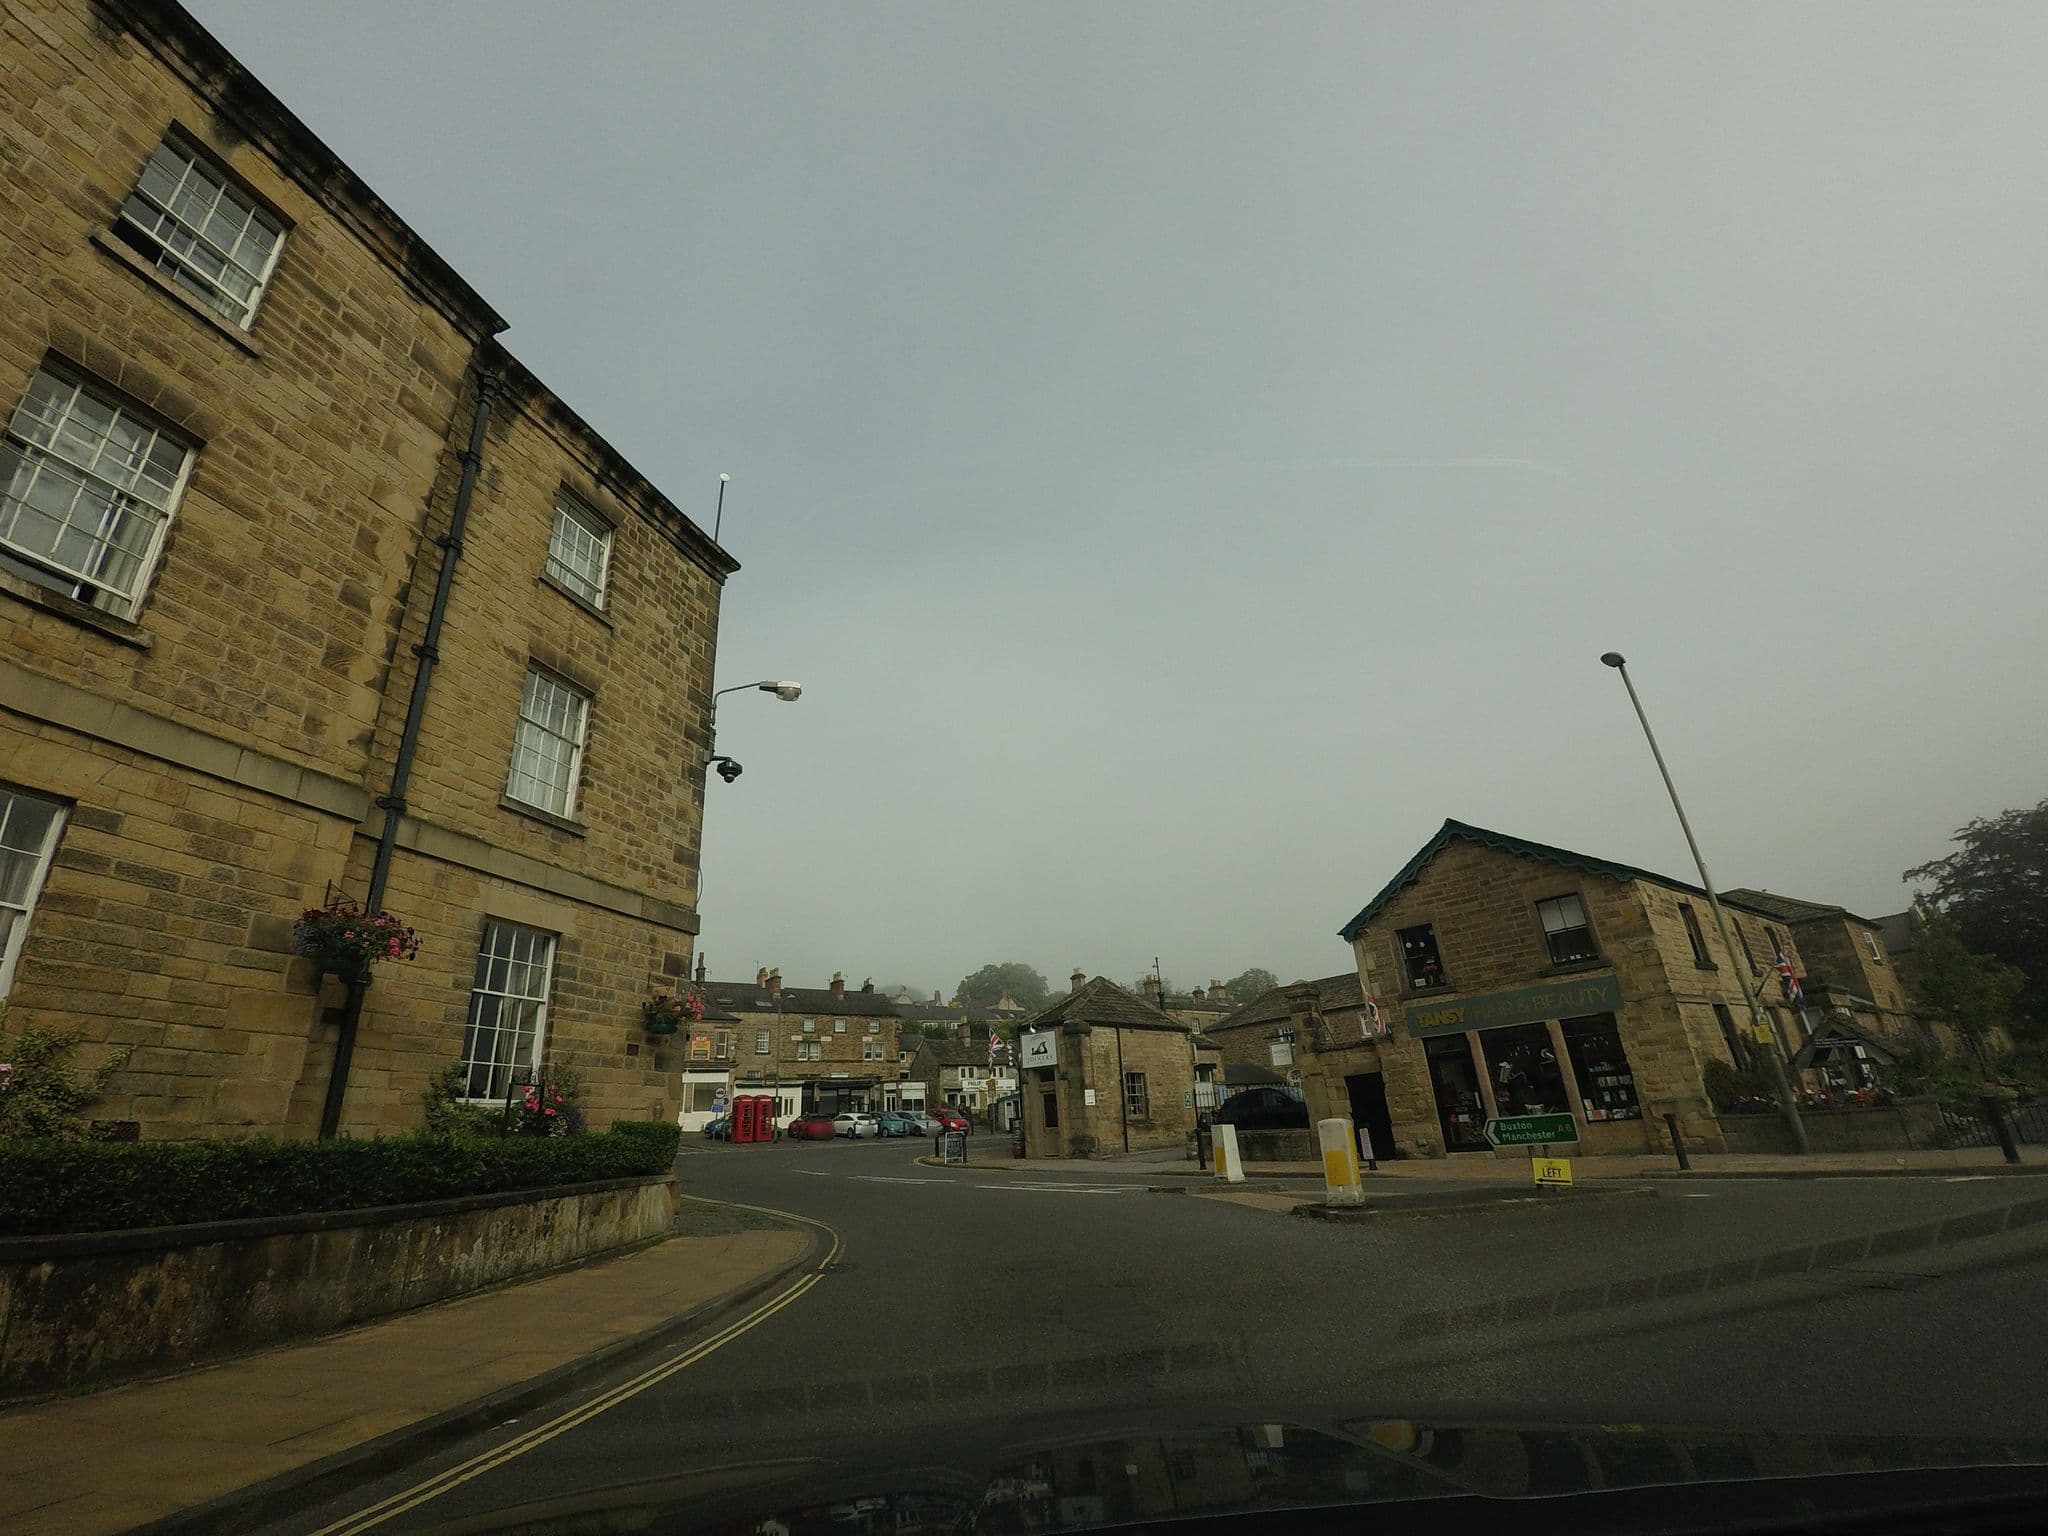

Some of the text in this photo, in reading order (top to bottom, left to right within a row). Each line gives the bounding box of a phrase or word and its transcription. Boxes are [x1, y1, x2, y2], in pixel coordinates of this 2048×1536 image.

[1416, 1008, 1465, 1029] TANSY
[1532, 987, 1609, 1010] BEAUTY
[1500, 1122, 1532, 1131] Buxton
[1558, 1124, 1572, 1133] A6
[1502, 1131, 1555, 1141] Manchester
[1542, 1167, 1561, 1178] LEFT
